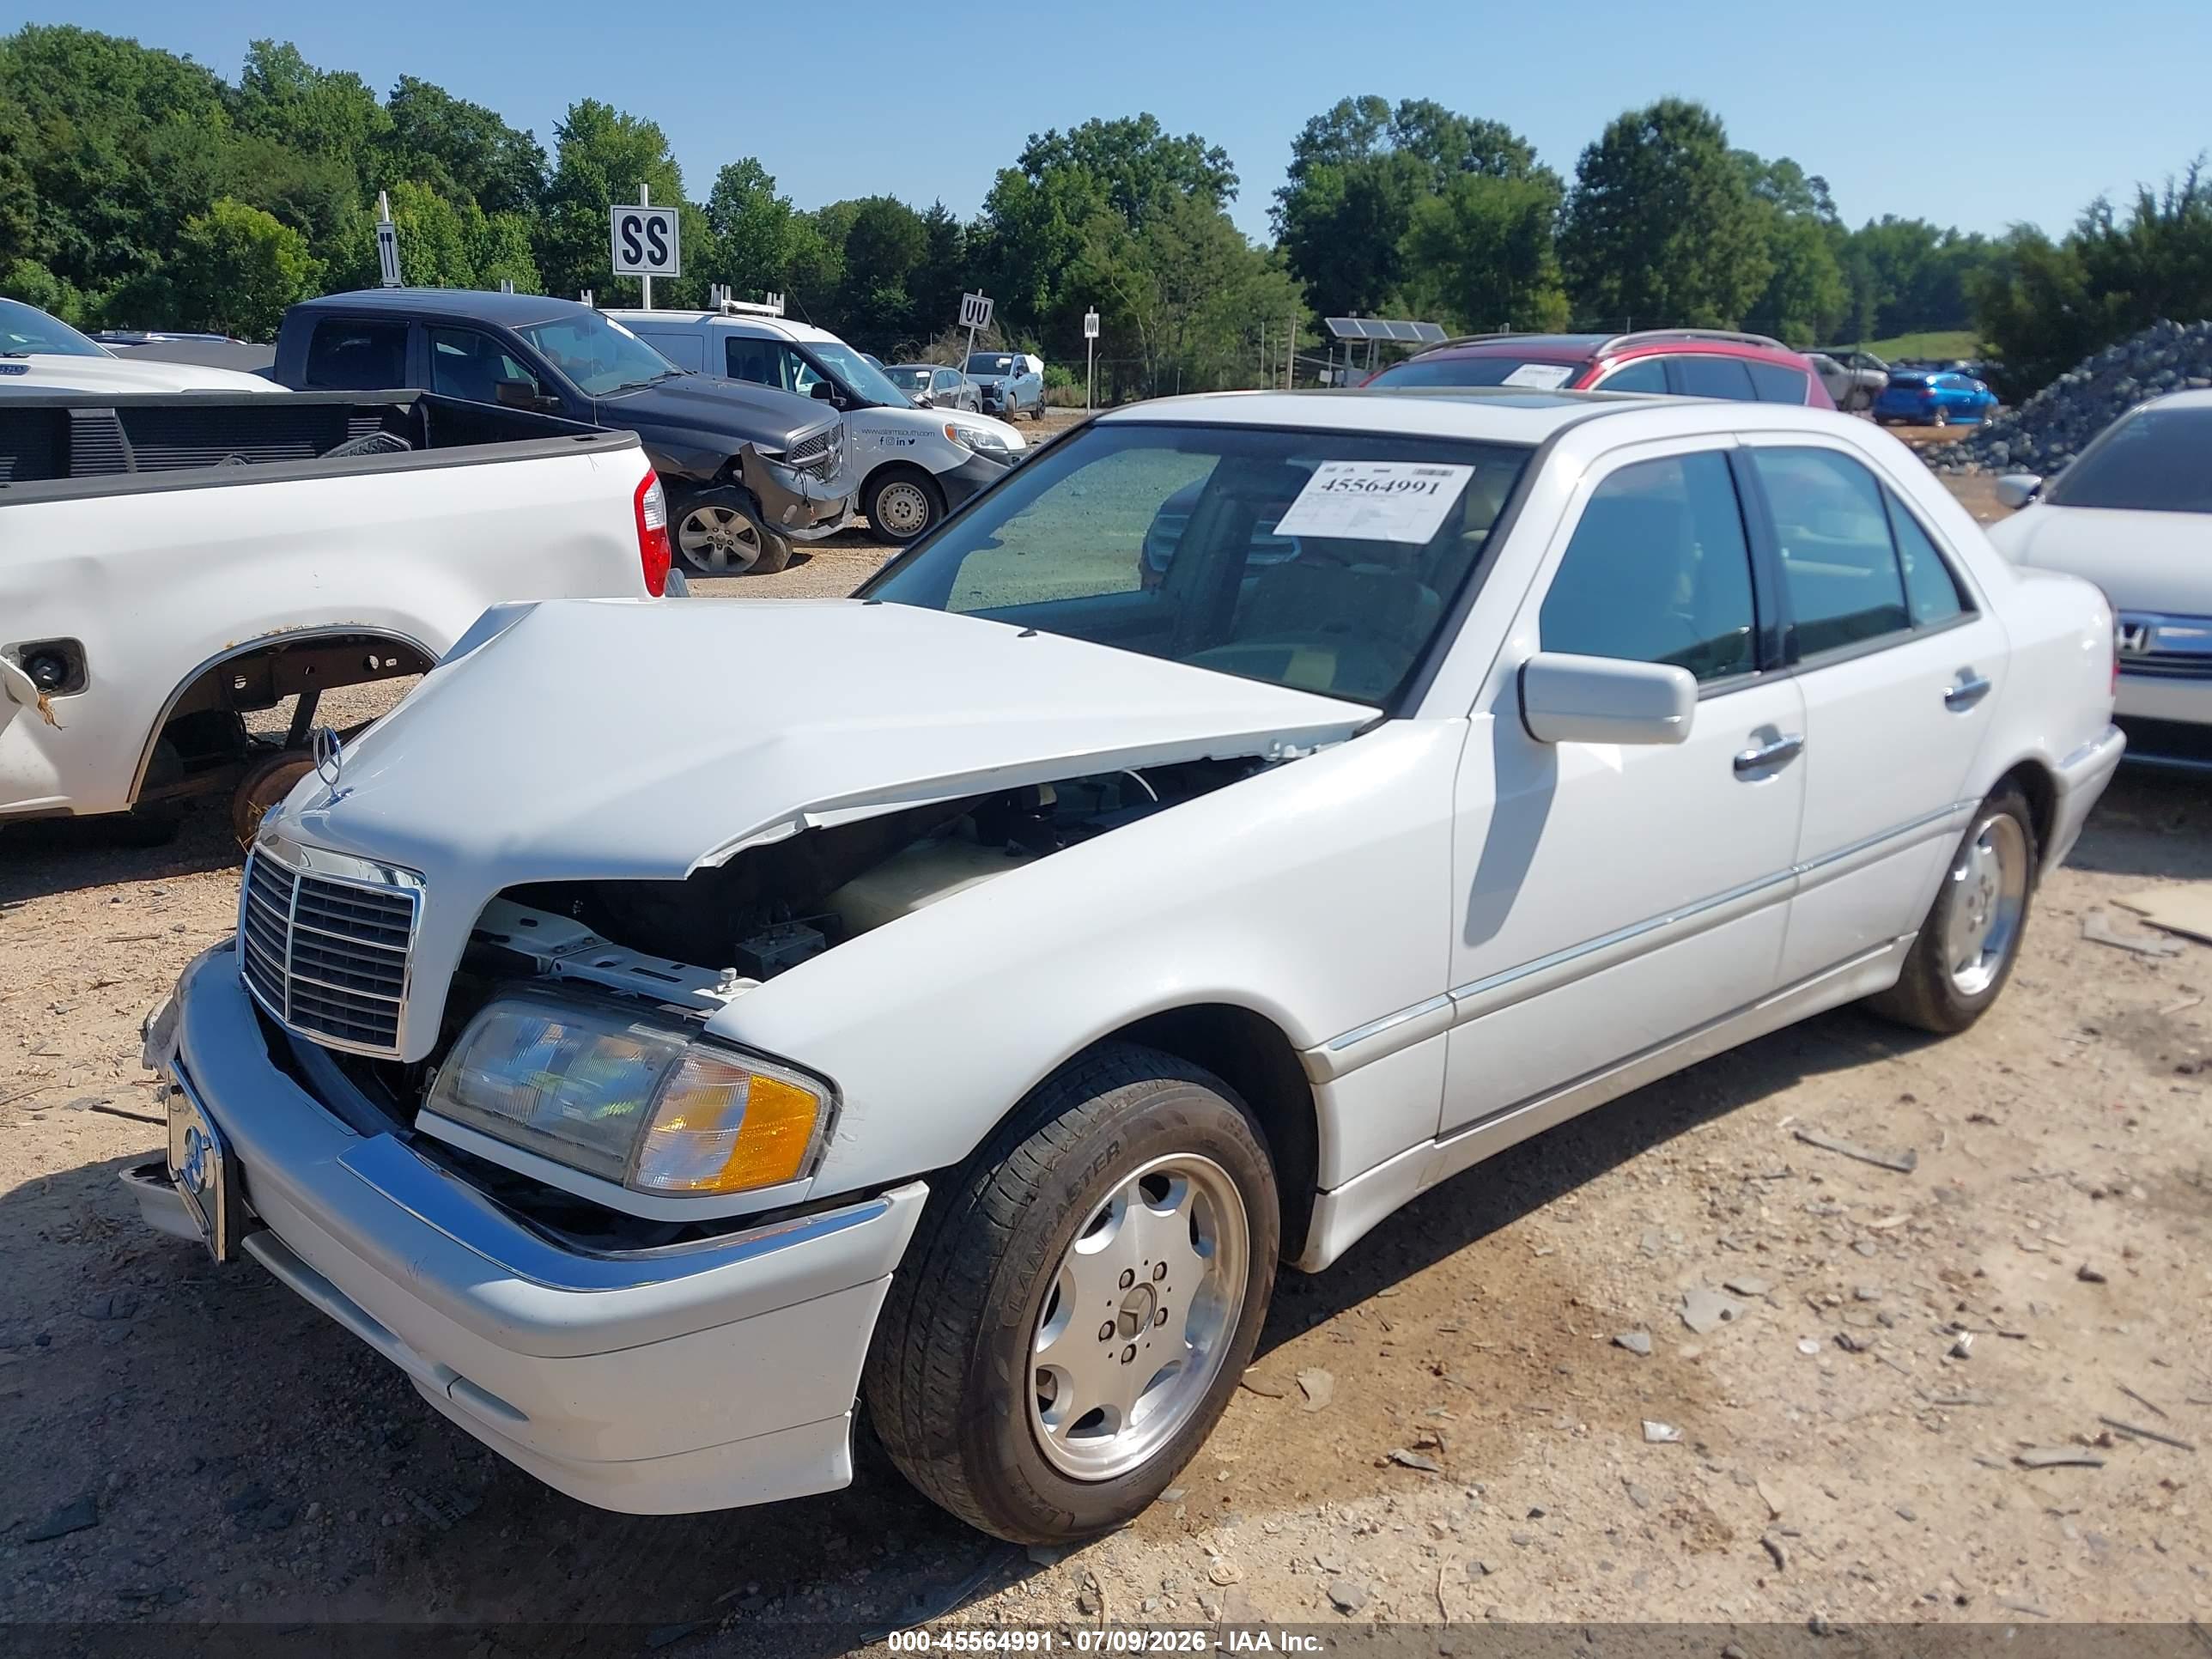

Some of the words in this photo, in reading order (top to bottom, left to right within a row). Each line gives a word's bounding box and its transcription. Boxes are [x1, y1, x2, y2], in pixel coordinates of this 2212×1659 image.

[622, 215, 668, 266] SS
[965, 299, 988, 325] UU
[1321, 477, 1440, 495] 45564991
